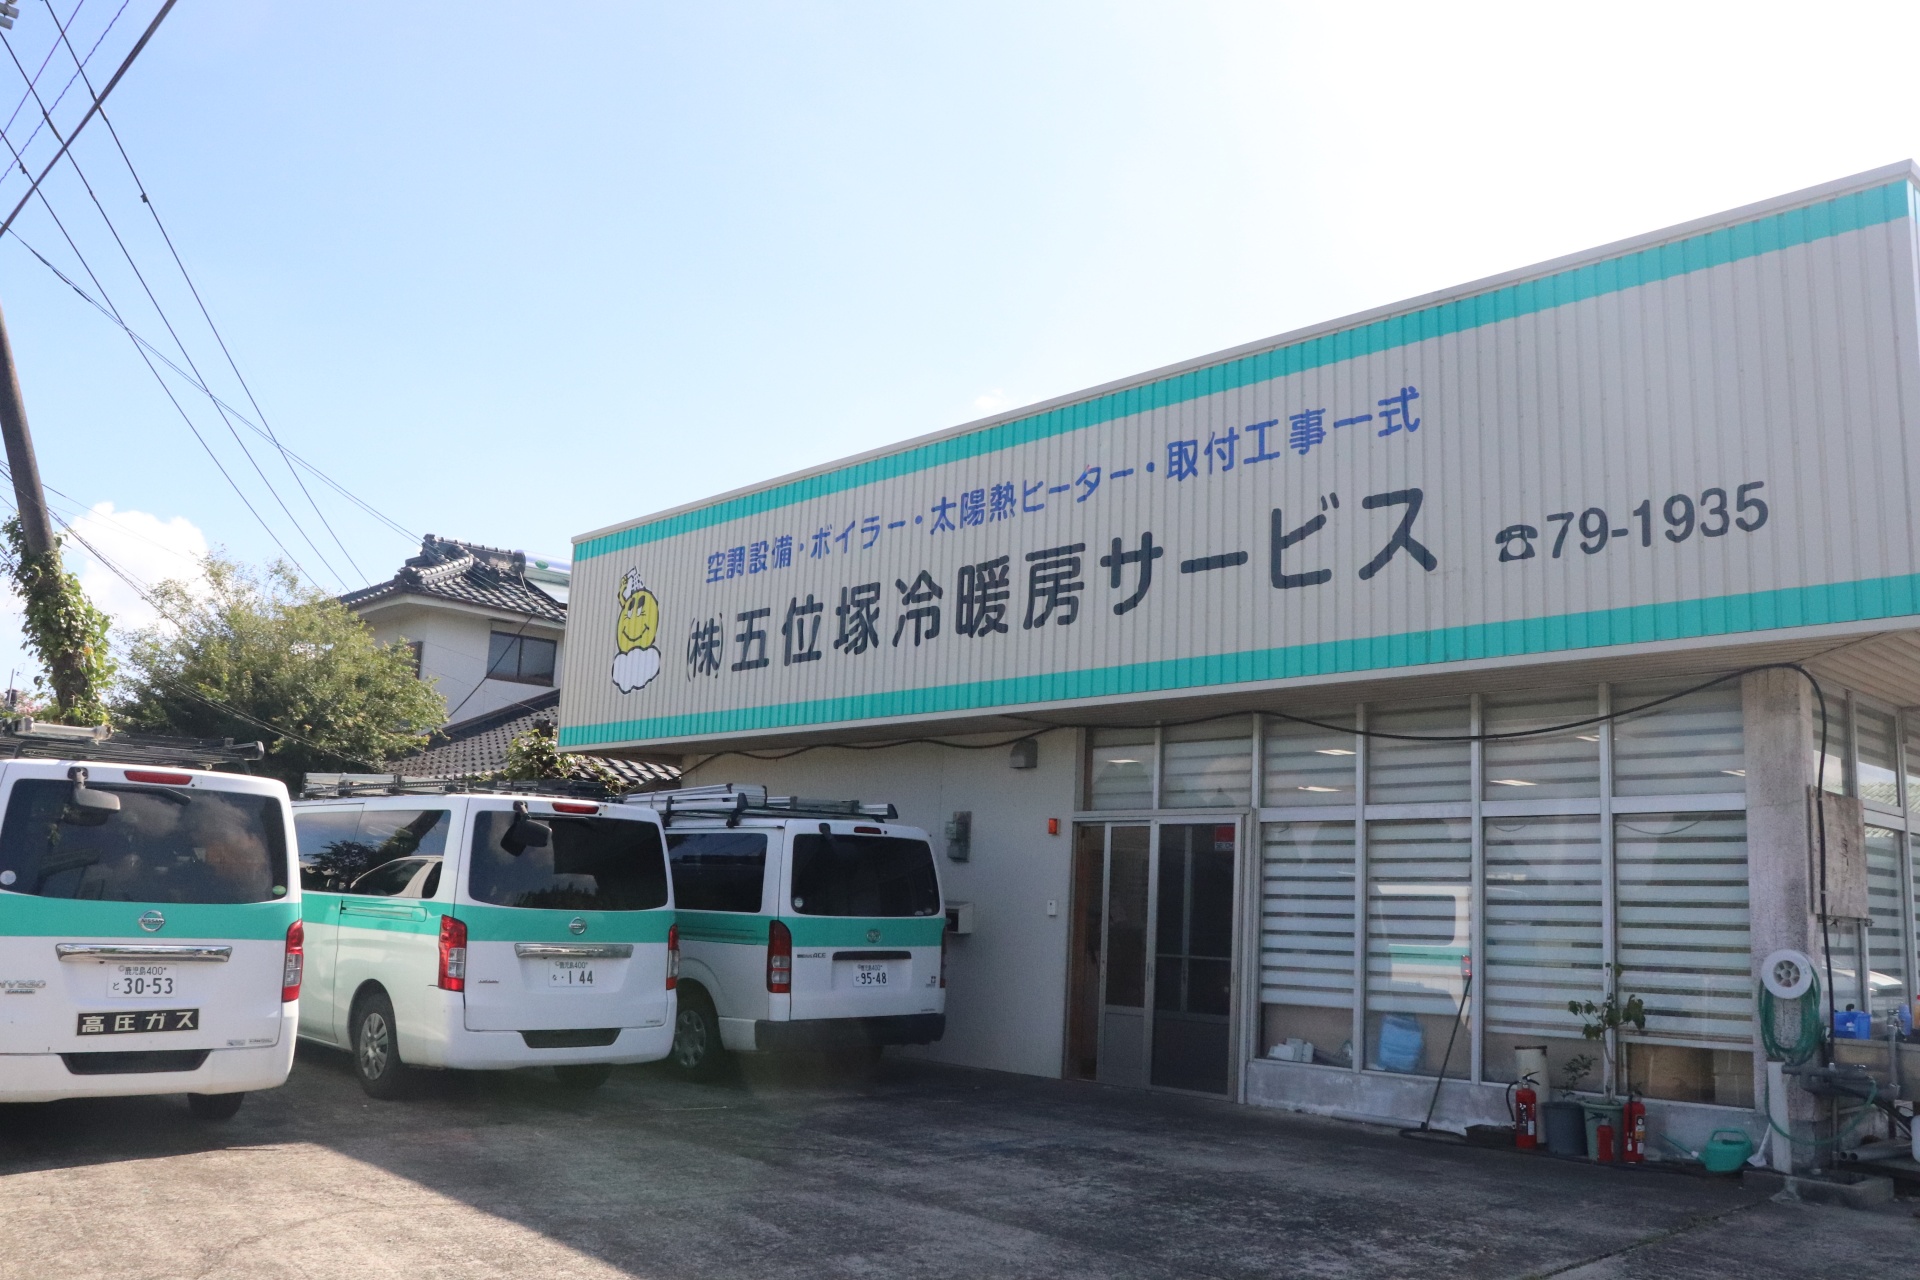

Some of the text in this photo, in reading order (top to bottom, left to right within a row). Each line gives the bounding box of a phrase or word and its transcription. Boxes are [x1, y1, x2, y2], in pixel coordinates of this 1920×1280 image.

[1546, 481, 1769, 559] 79-1935
[124, 977, 173, 994] 30-53
[861, 972, 887, 984] 95-48
[82, 1010, 194, 1033] 高圧ガス
